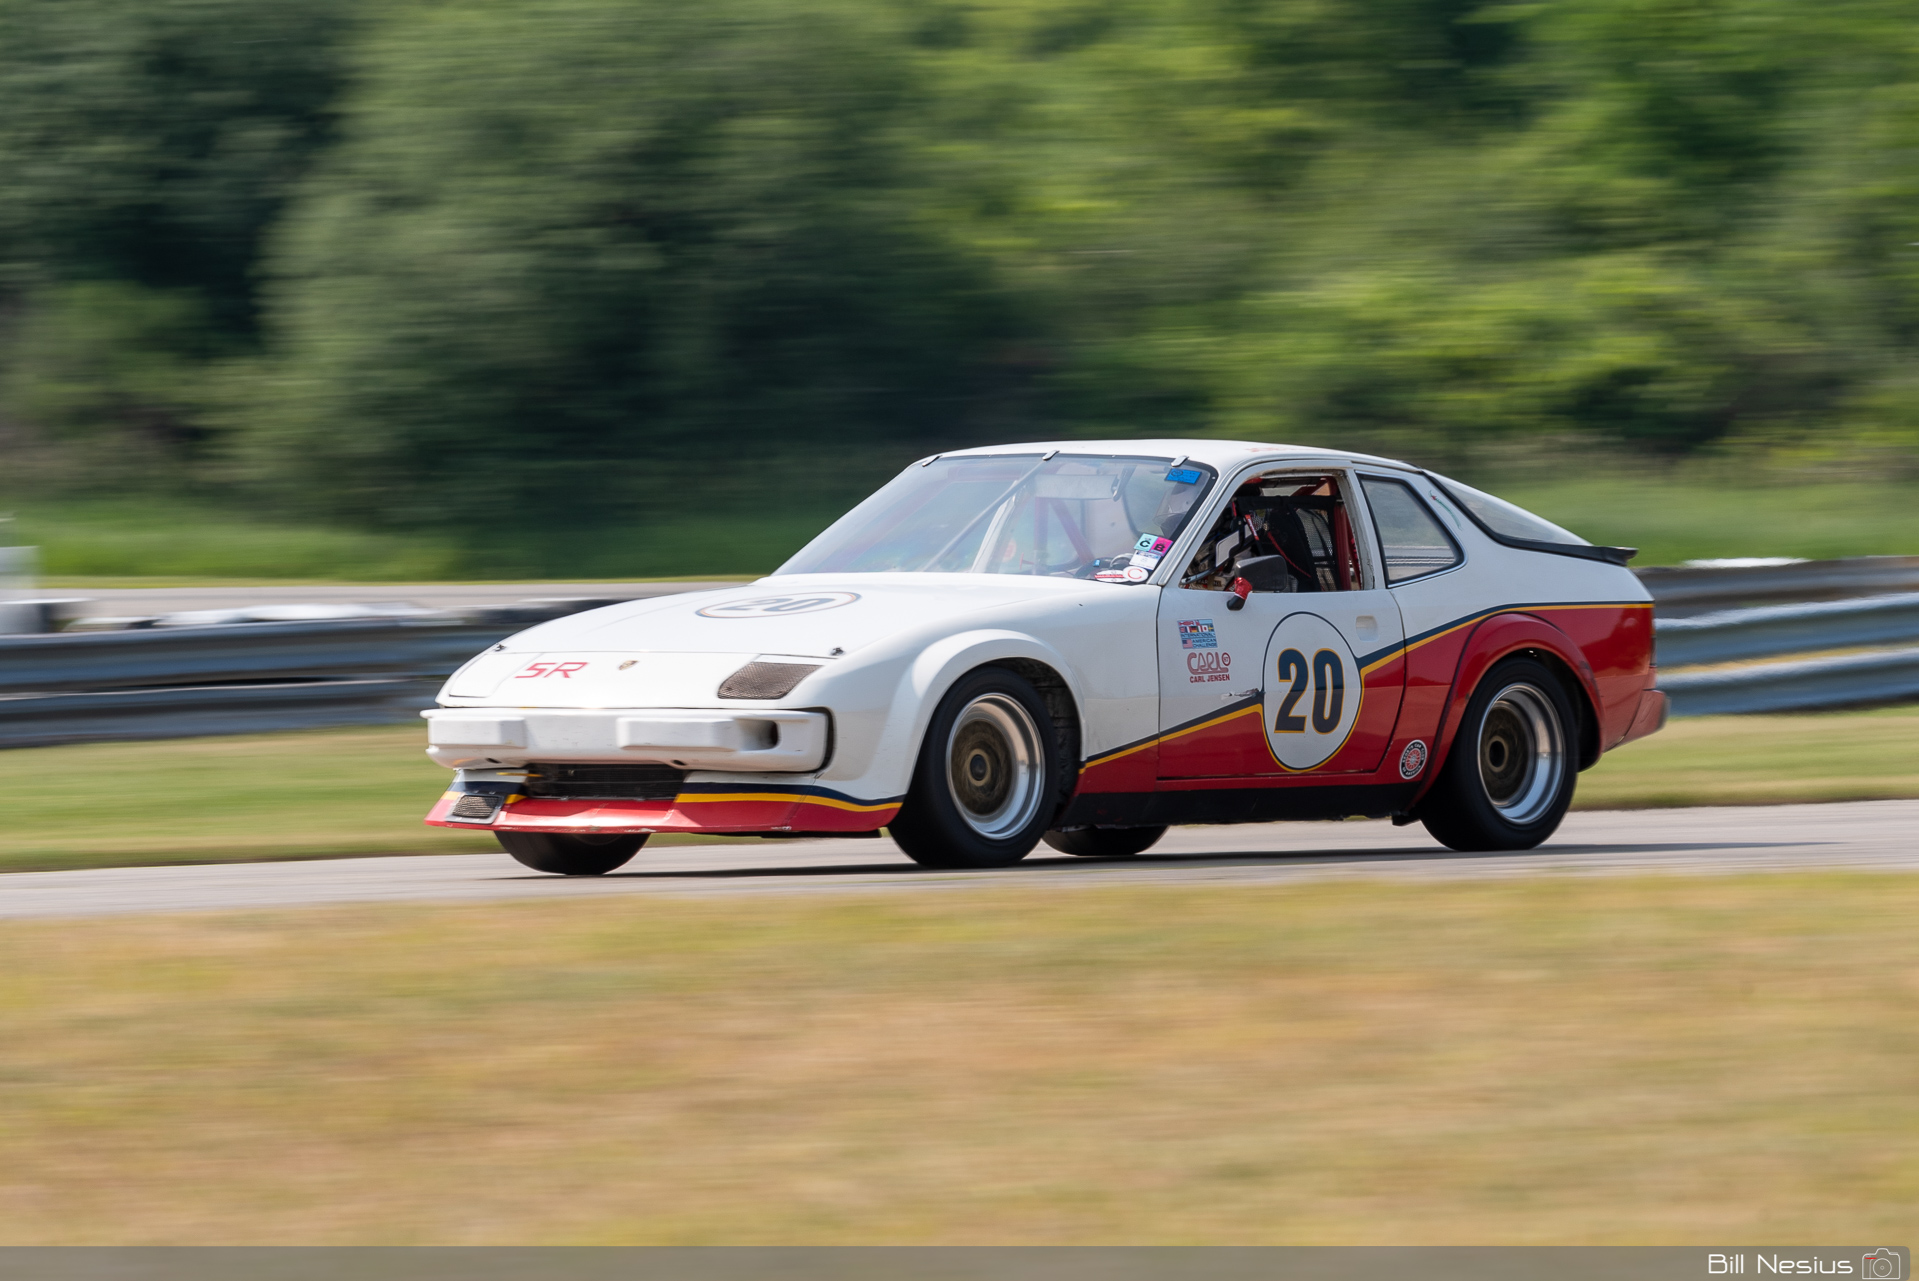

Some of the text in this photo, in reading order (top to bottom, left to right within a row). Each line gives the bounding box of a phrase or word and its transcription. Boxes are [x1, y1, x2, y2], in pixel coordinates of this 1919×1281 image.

[514, 662, 590, 679] SR
[1190, 675, 1206, 683] CARL
[1207, 674, 1230, 682] JENSEN
[1274, 647, 1345, 735] 20
